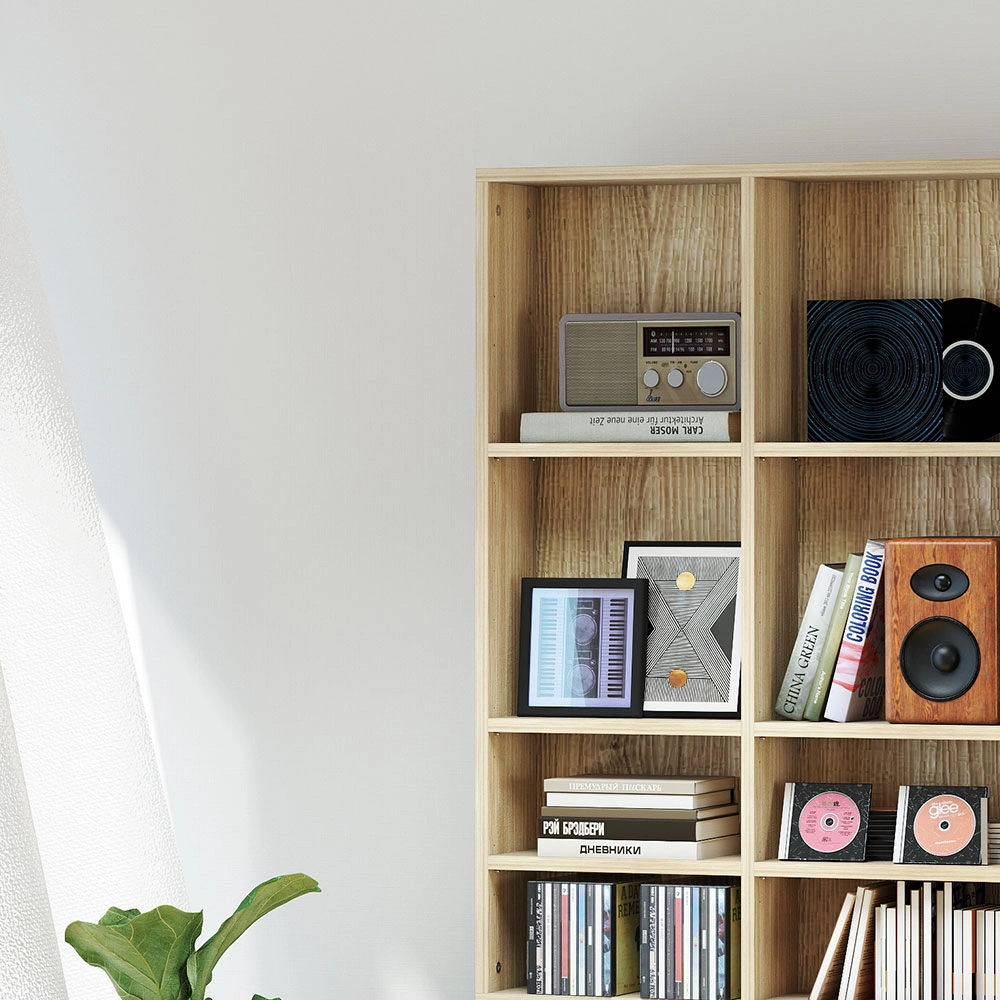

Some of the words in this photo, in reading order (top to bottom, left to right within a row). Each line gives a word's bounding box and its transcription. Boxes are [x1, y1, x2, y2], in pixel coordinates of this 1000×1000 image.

[589, 417, 604, 426] Zeit
[628, 417, 645, 425] eine
[647, 416, 658, 425] für
[660, 416, 704, 425] Architektur
[650, 426, 679, 435] MOSER
[684, 426, 703, 435] CARL
[846, 585, 873, 643] COLORING
[862, 551, 884, 586] BOOK
[783, 671, 806, 714] CHINA
[798, 625, 820, 669] GREEN
[543, 818, 559, 835] РЭЙ
[562, 821, 605, 836] БРЭДБЕРИ
[579, 845, 641, 855] ДНЕВНИКИ
[618, 900, 640, 918] REME
